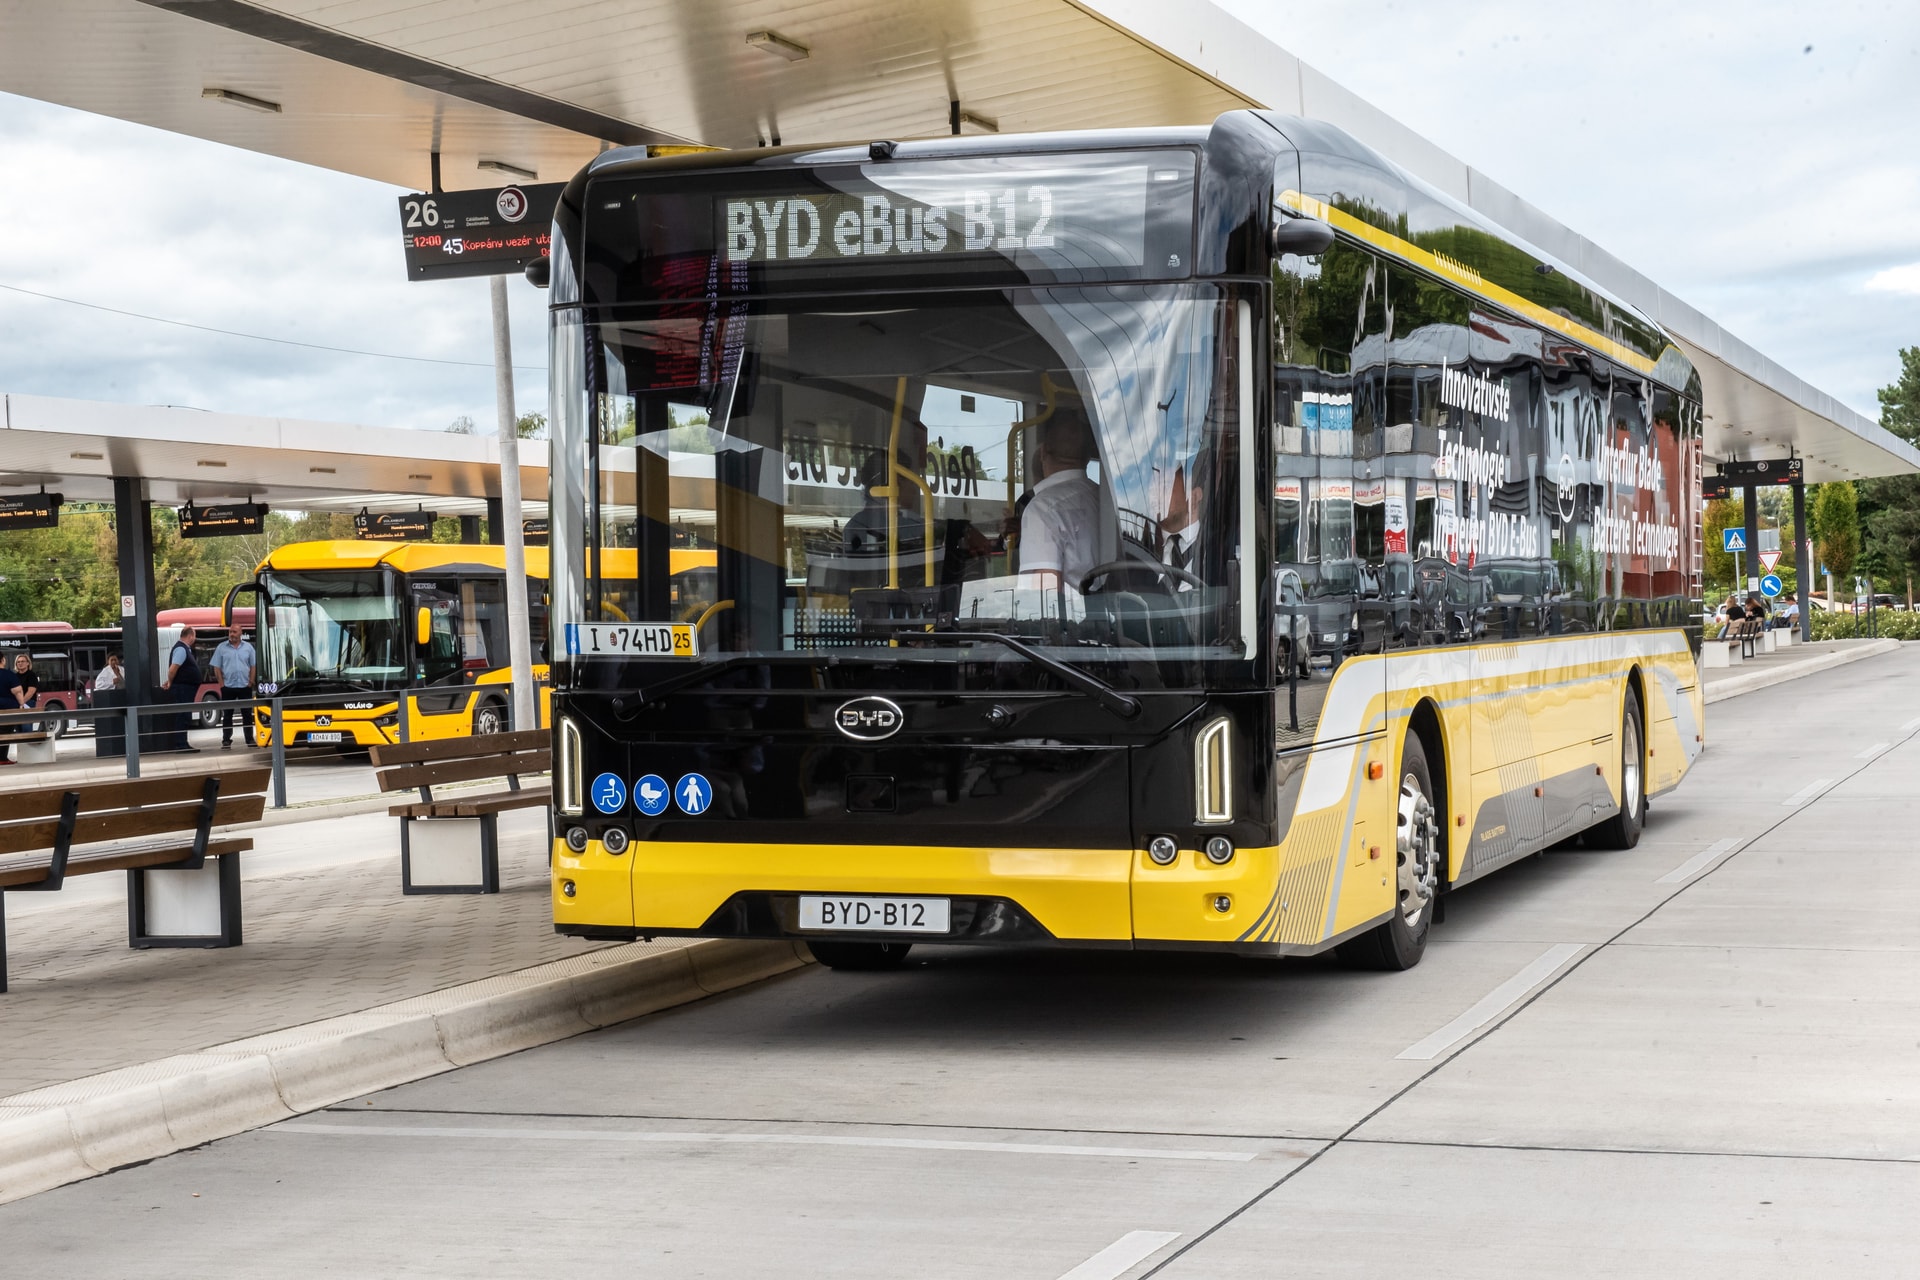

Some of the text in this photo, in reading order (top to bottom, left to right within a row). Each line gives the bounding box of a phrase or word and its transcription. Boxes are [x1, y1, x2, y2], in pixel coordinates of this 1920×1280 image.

[404, 199, 439, 228] 26
[727, 185, 1055, 261] BYD eBus B12
[413, 233, 552, 255] 12:00 45 Koppány vezér utc
[1440, 356, 1510, 423] Innovativste
[1438, 429, 1505, 500] Technologie
[1596, 433, 1662, 492] Unterflur Blade
[1788, 460, 1801, 470] 29
[1559, 476, 1574, 501] BYD
[179, 510, 192, 520] 14
[355, 516, 367, 526] 15
[1487, 511, 1508, 556] BYD
[1510, 513, 1537, 558] E-Bus
[1593, 505, 1679, 570] Batterie Technologie
[590, 628, 690, 652] I 74HD 25
[842, 710, 895, 727] BYD
[822, 901, 926, 927] BYD-B12
